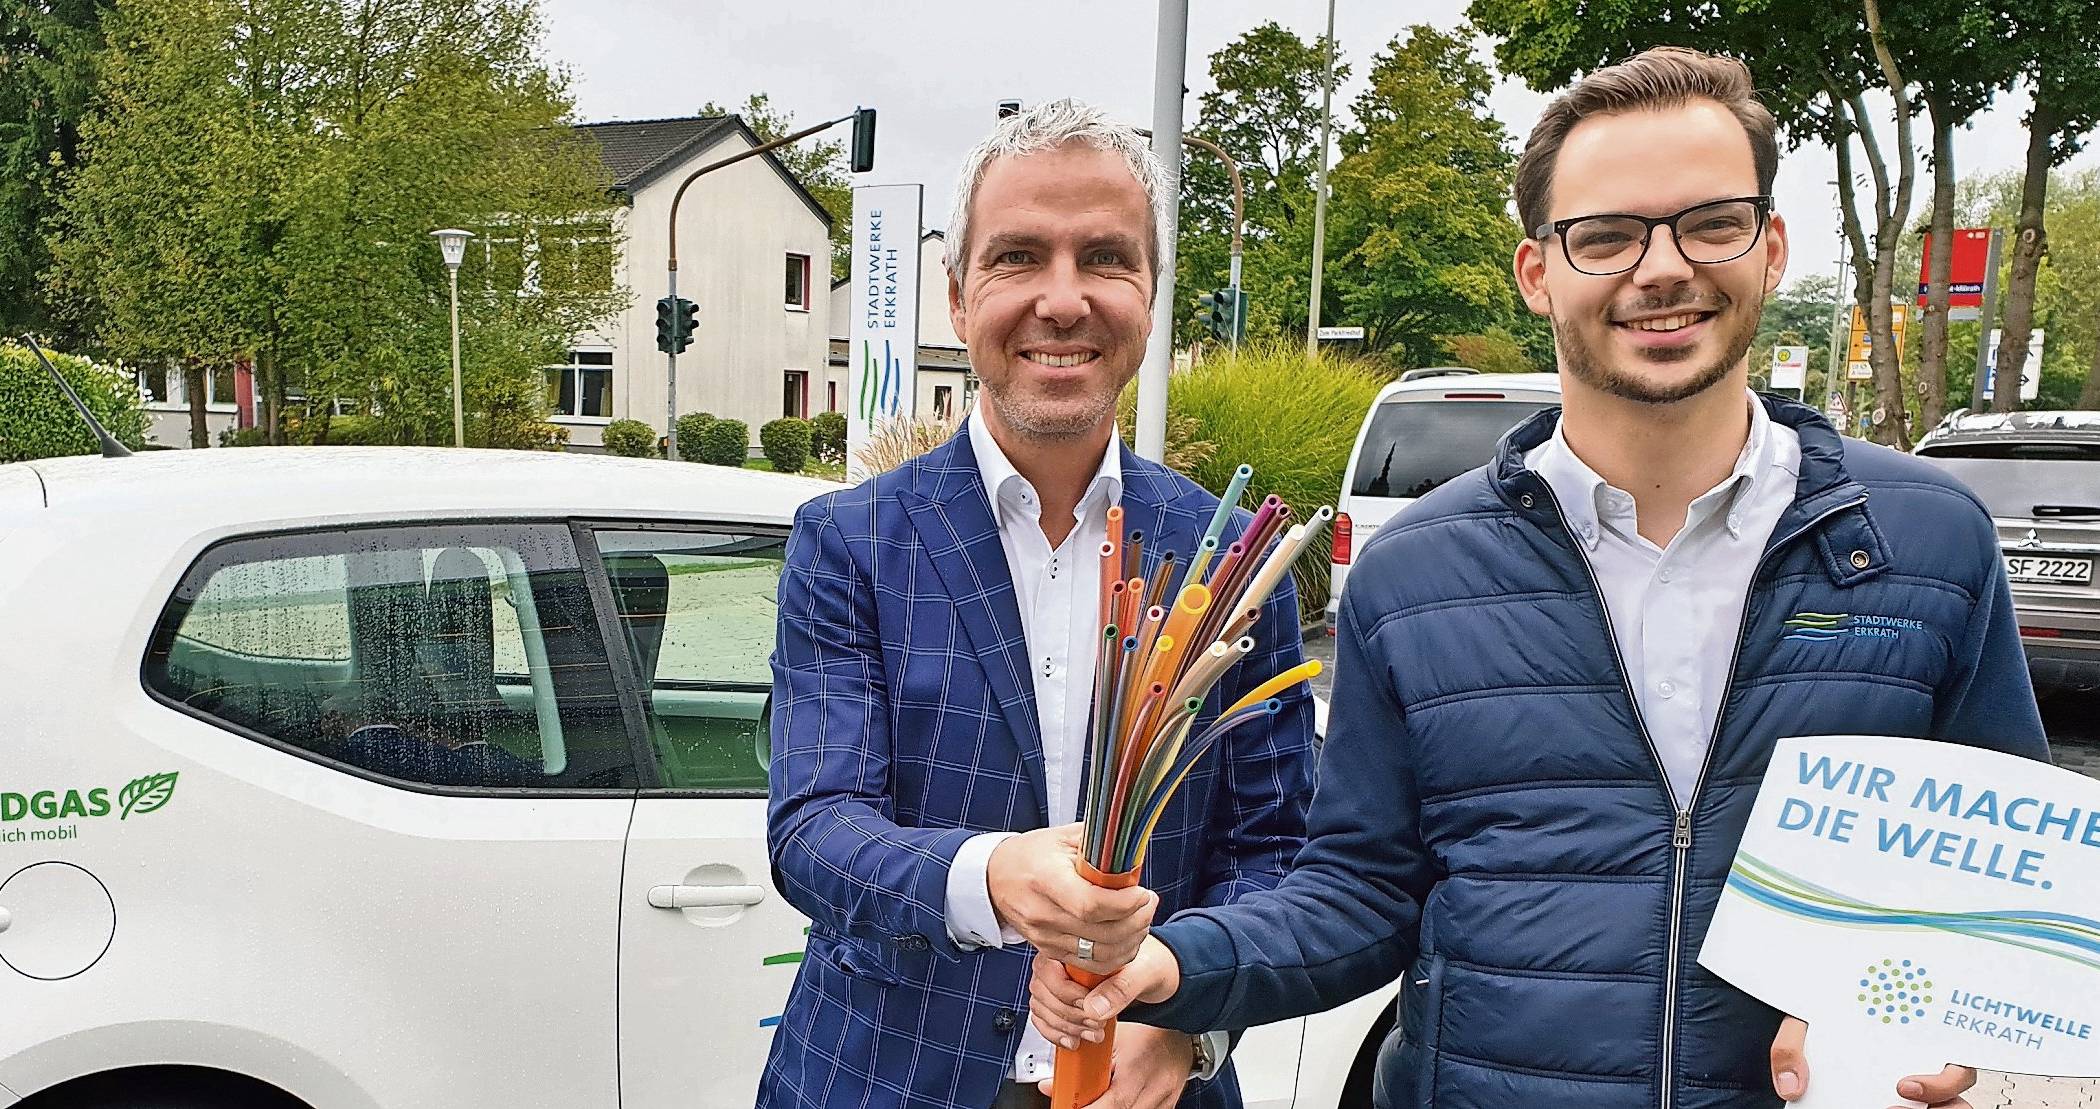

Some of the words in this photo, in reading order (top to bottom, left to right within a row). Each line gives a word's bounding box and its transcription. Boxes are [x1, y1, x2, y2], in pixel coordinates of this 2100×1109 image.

[867, 210, 882, 329] STADTWERKE
[884, 249, 898, 328] ERKRATH
[2007, 558, 2034, 575] SF
[2036, 560, 2089, 579] 2222
[1853, 615, 1923, 630] STADTWERKE
[1854, 626, 1900, 640] ERKRATH
[0, 787, 112, 822] DGAS
[1799, 751, 1896, 803] WIR
[1909, 777, 2100, 848] MACHE
[30, 824, 78, 841] mobil
[1776, 797, 1859, 844] DIE
[1877, 817, 2054, 891] WELLE.
[1943, 1009, 2044, 1050] ERKRATH
[1950, 989, 2093, 1040] LICHTWELLE
